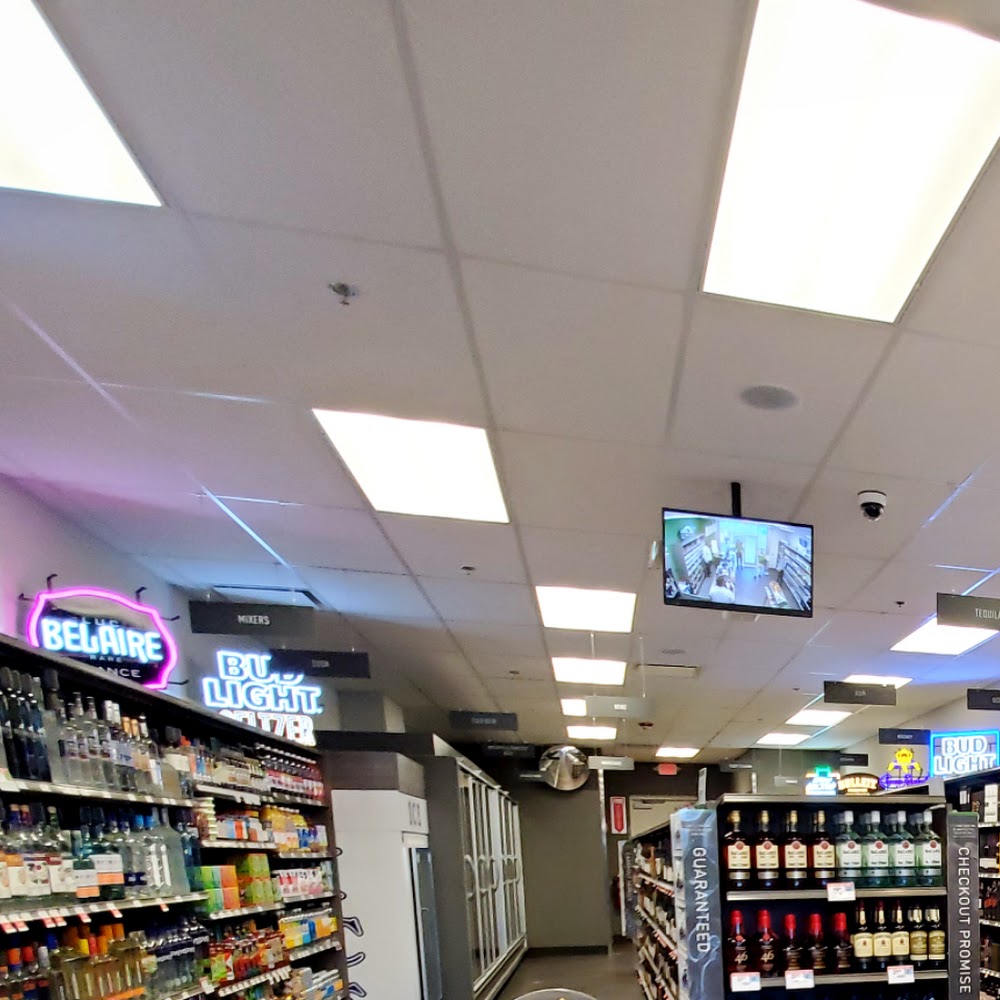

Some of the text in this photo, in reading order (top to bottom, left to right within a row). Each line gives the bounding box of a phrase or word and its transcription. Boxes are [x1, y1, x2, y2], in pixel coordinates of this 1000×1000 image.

[237, 615, 270, 625] MIXERS
[41, 618, 163, 663] BELAIRE
[202, 677, 323, 715] LIGHT
[941, 735, 988, 756] BUD
[933, 753, 997, 776] LIGHT
[692, 847, 711, 953] GUARANTEED
[958, 847, 971, 926] CHECKOUT
[735, 950, 748, 964] 46
[760, 950, 775, 963] 46
[959, 930, 972, 993] PROMISE
